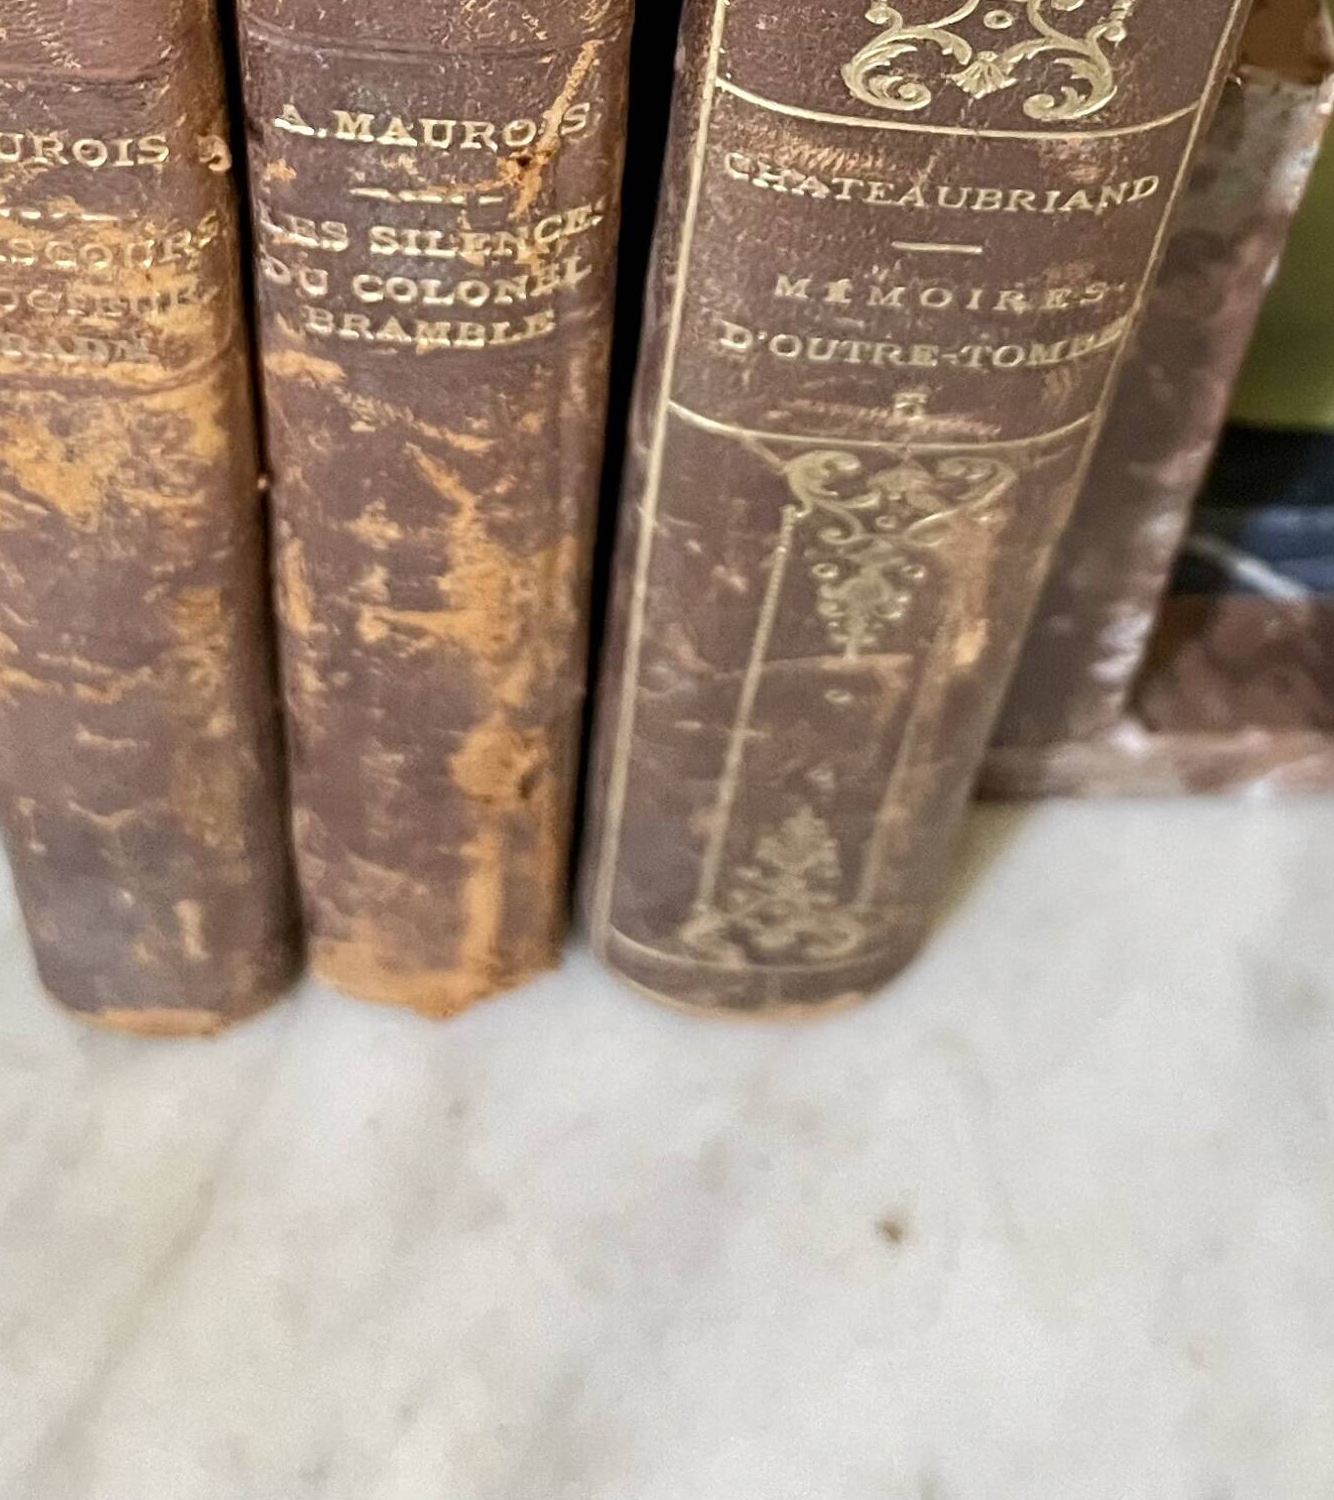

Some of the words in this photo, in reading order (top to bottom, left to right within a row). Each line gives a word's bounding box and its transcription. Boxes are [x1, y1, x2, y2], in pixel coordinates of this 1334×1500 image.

[274, 103, 592, 152] A.MAUROS
[724, 152, 1159, 213] CHATEAUBRIAND
[351, 255, 593, 307] COLONEL
[301, 303, 557, 347] BRAMBLE
